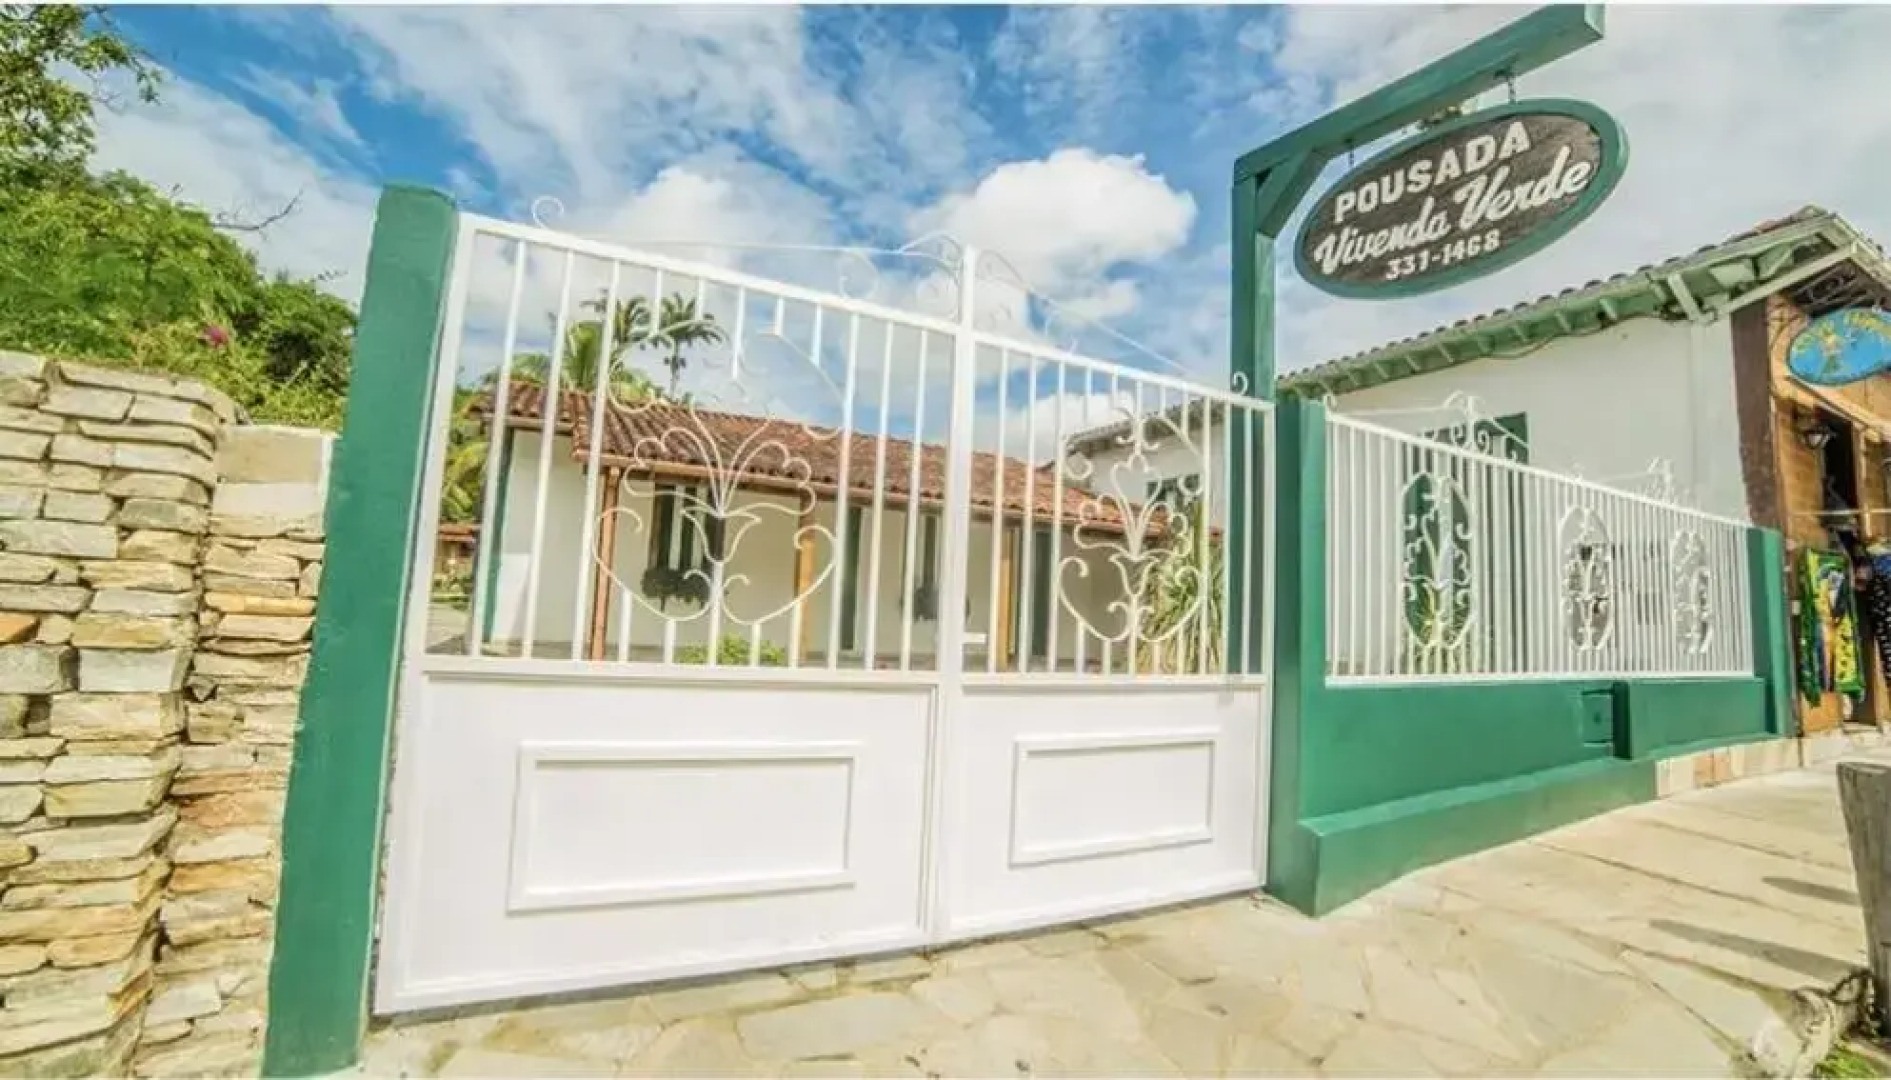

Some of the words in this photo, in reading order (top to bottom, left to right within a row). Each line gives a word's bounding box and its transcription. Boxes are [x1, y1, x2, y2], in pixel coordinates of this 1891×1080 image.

[1313, 197, 1451, 275] Vivenda
[1454, 145, 1592, 230] Verde
[1334, 121, 1530, 223] POUSADA
[1385, 228, 1501, 281] 331-1468
